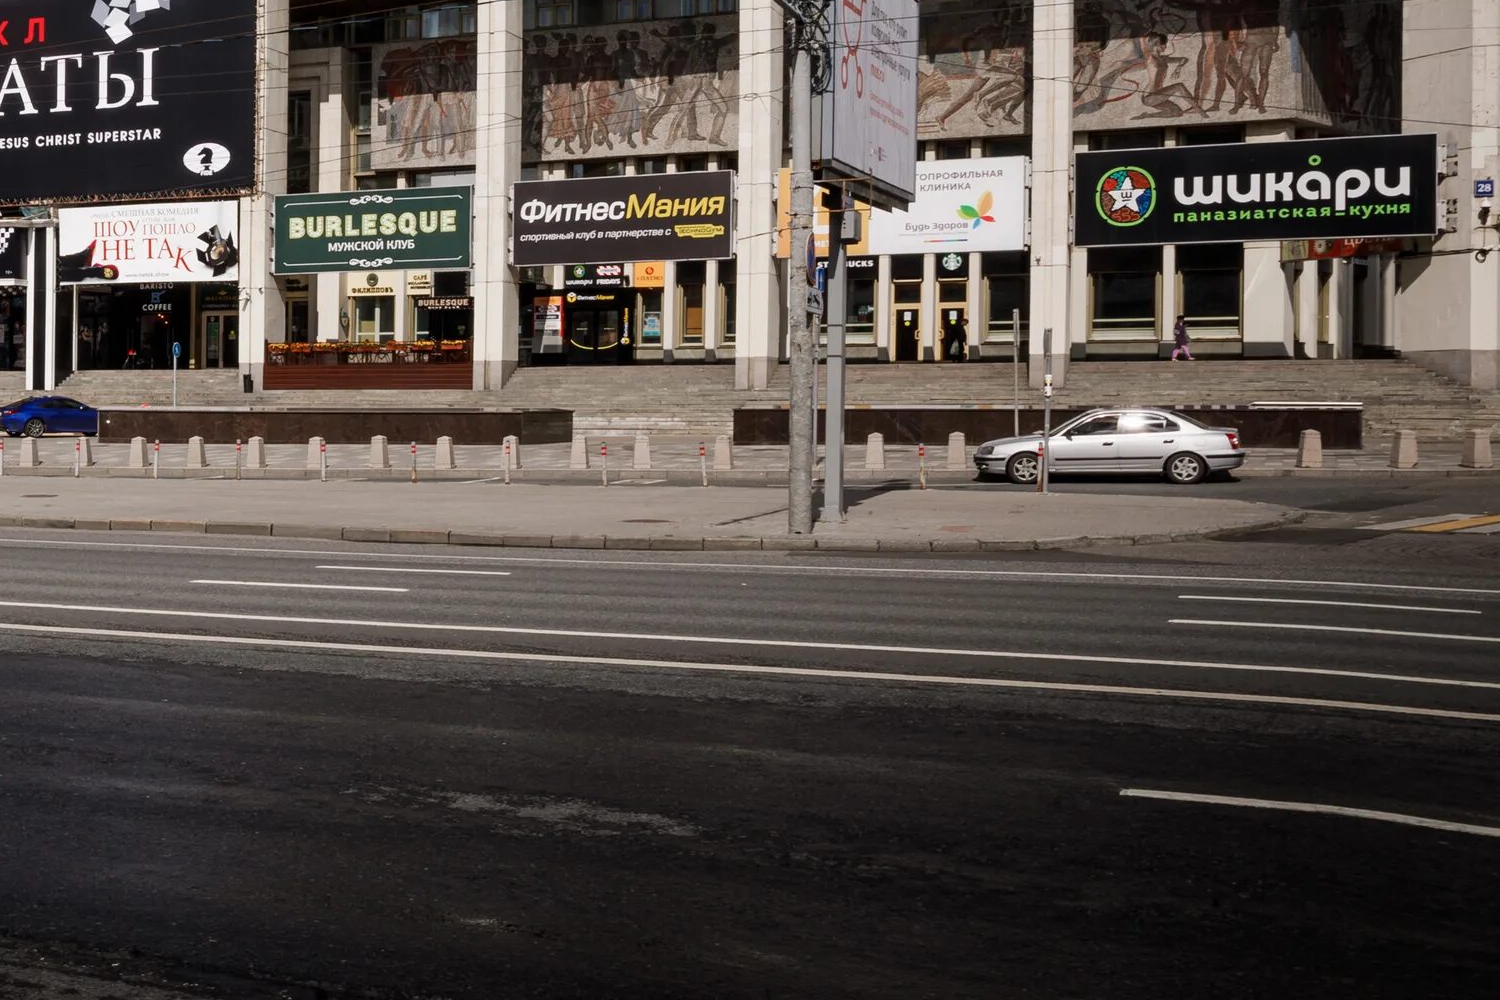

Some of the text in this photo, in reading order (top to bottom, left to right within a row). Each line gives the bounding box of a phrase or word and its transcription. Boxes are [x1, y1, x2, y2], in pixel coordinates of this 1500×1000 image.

[35, 132, 82, 147] CHRIST
[86, 128, 162, 144] SUPERSTAR
[916, 169, 1003, 181] ОПРОФИЛЬНАЯ
[920, 182, 972, 192] КЛИНИКА
[1477, 183, 1492, 192] 28
[520, 192, 725, 223] ФитнесМания
[1173, 203, 1411, 223] паназиатская кухня
[94, 220, 196, 237] ШОУ ПОШЛО
[288, 209, 457, 240] BURLESQUE
[519, 231, 574, 244] спортивный
[575, 230, 596, 241] клуб
[597, 230, 603, 238] в
[604, 227, 663, 239] партнерстве
[328, 238, 416, 252] МУЖСКОЙ КЛУБ
[102, 238, 193, 273] НЕ ТАК
[817, 260, 874, 268] STUCKS
[142, 303, 172, 311] COFFEE
[418, 298, 469, 307] BURLESQUE
